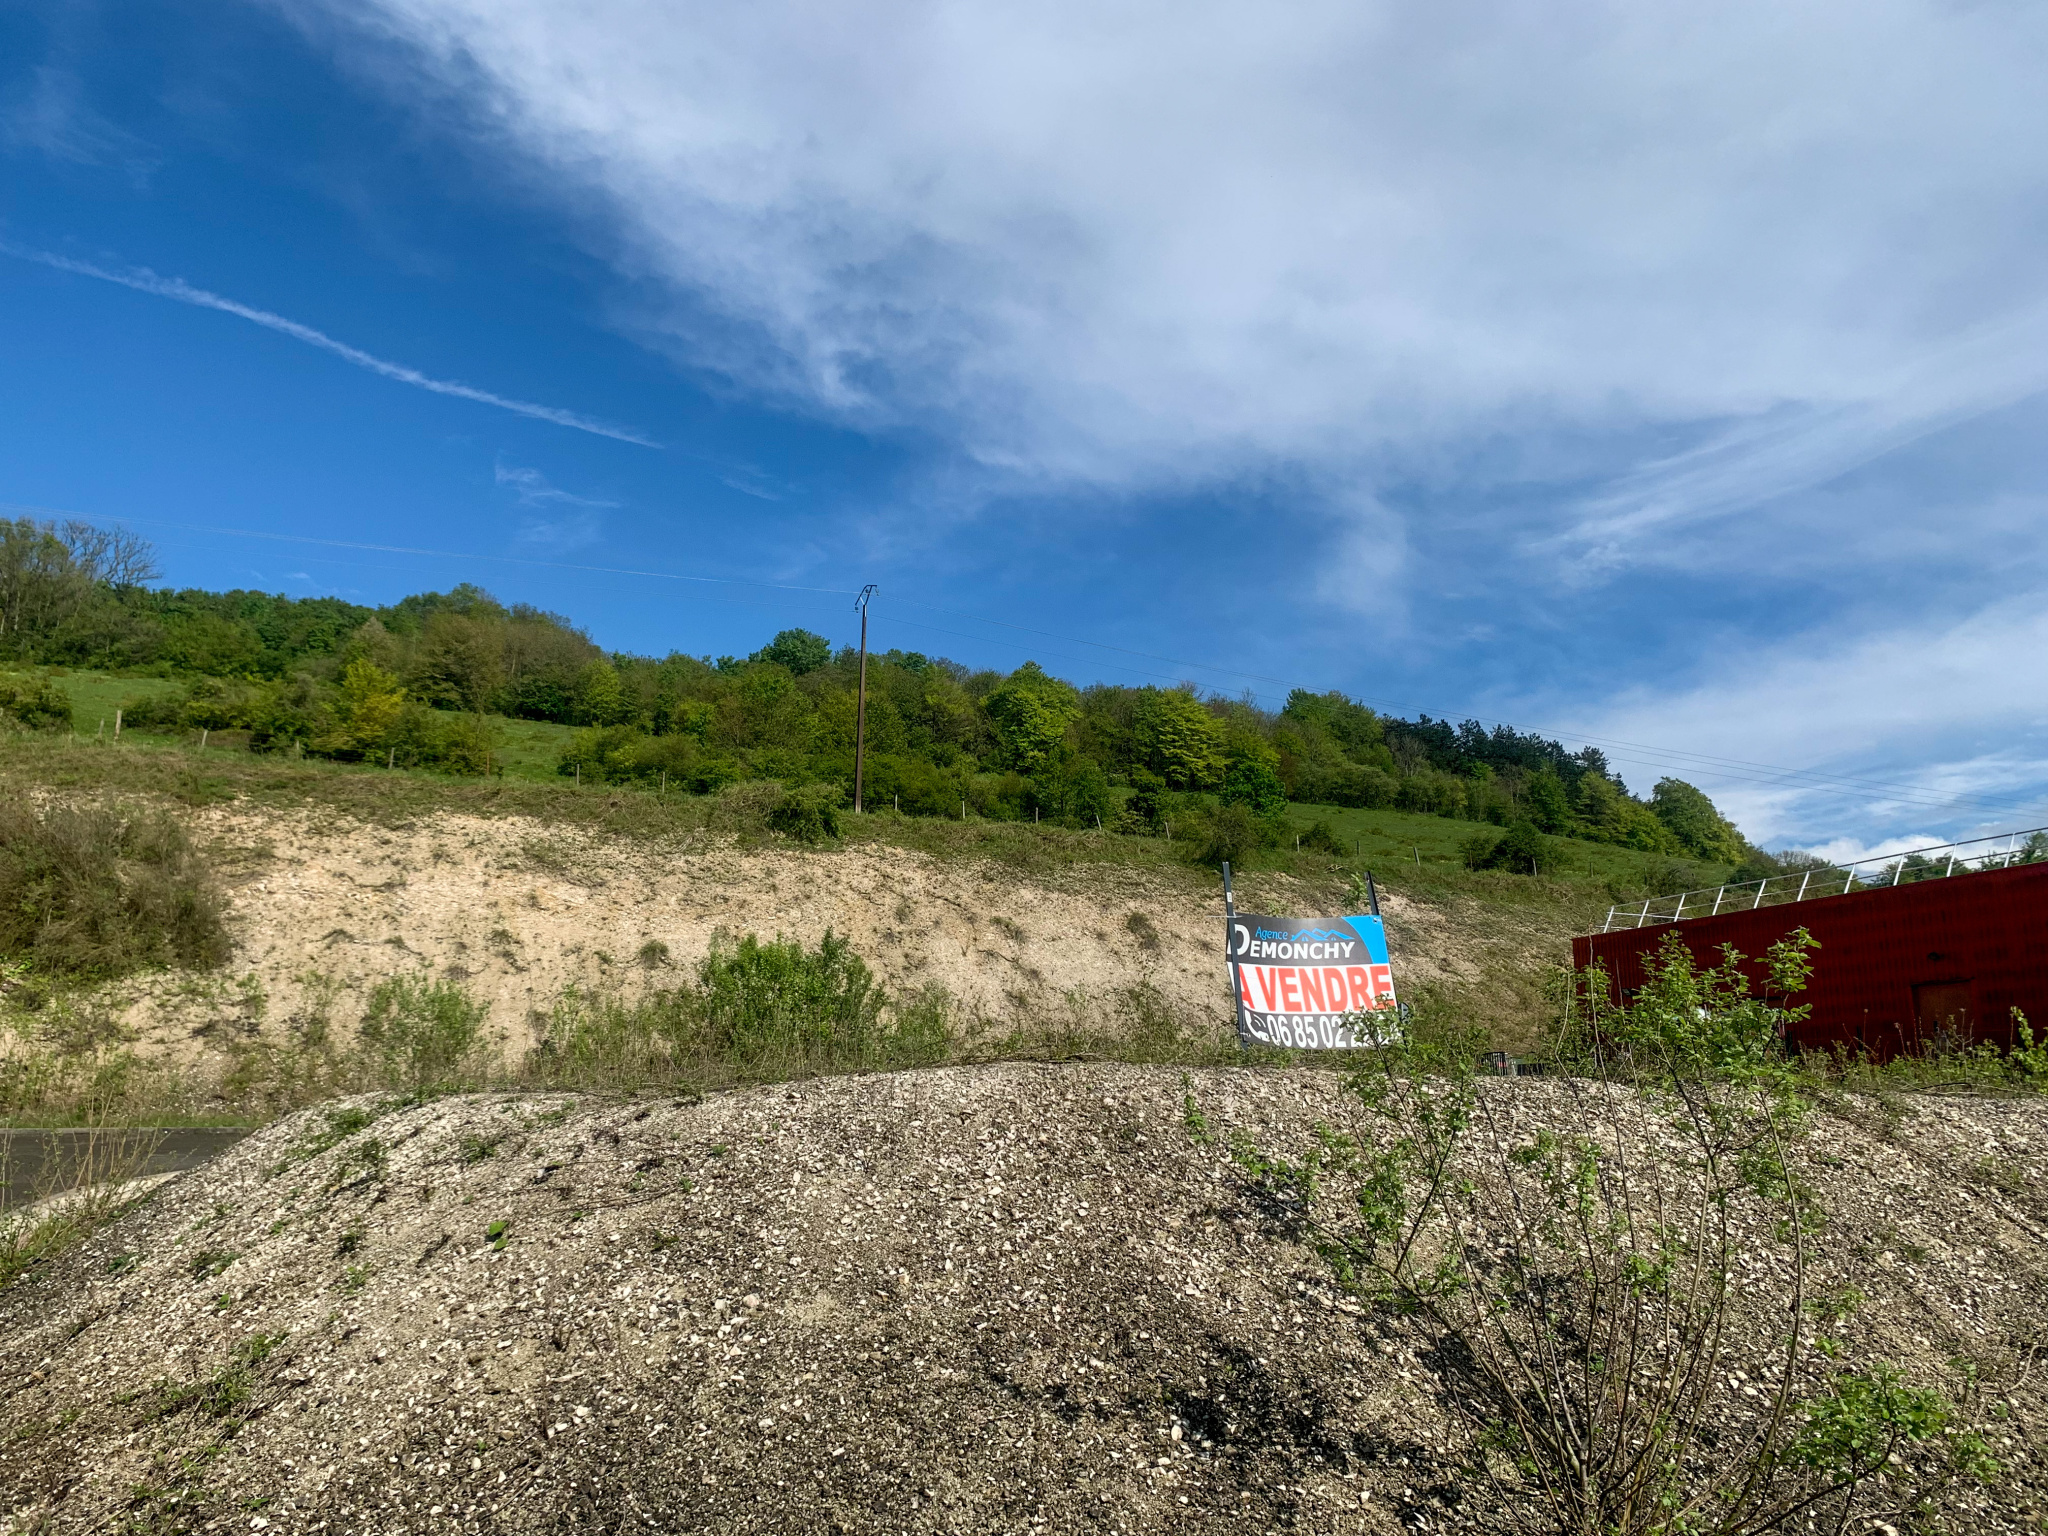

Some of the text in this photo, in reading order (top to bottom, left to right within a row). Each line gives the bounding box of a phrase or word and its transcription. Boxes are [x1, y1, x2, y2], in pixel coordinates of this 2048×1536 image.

[1227, 924, 1355, 960] DEMONCHY
[1255, 926, 1289, 941] Agence
[1255, 965, 1396, 1012] VENDRE
[1266, 1014, 1293, 1048] 06
[1292, 1015, 1319, 1049] 85
